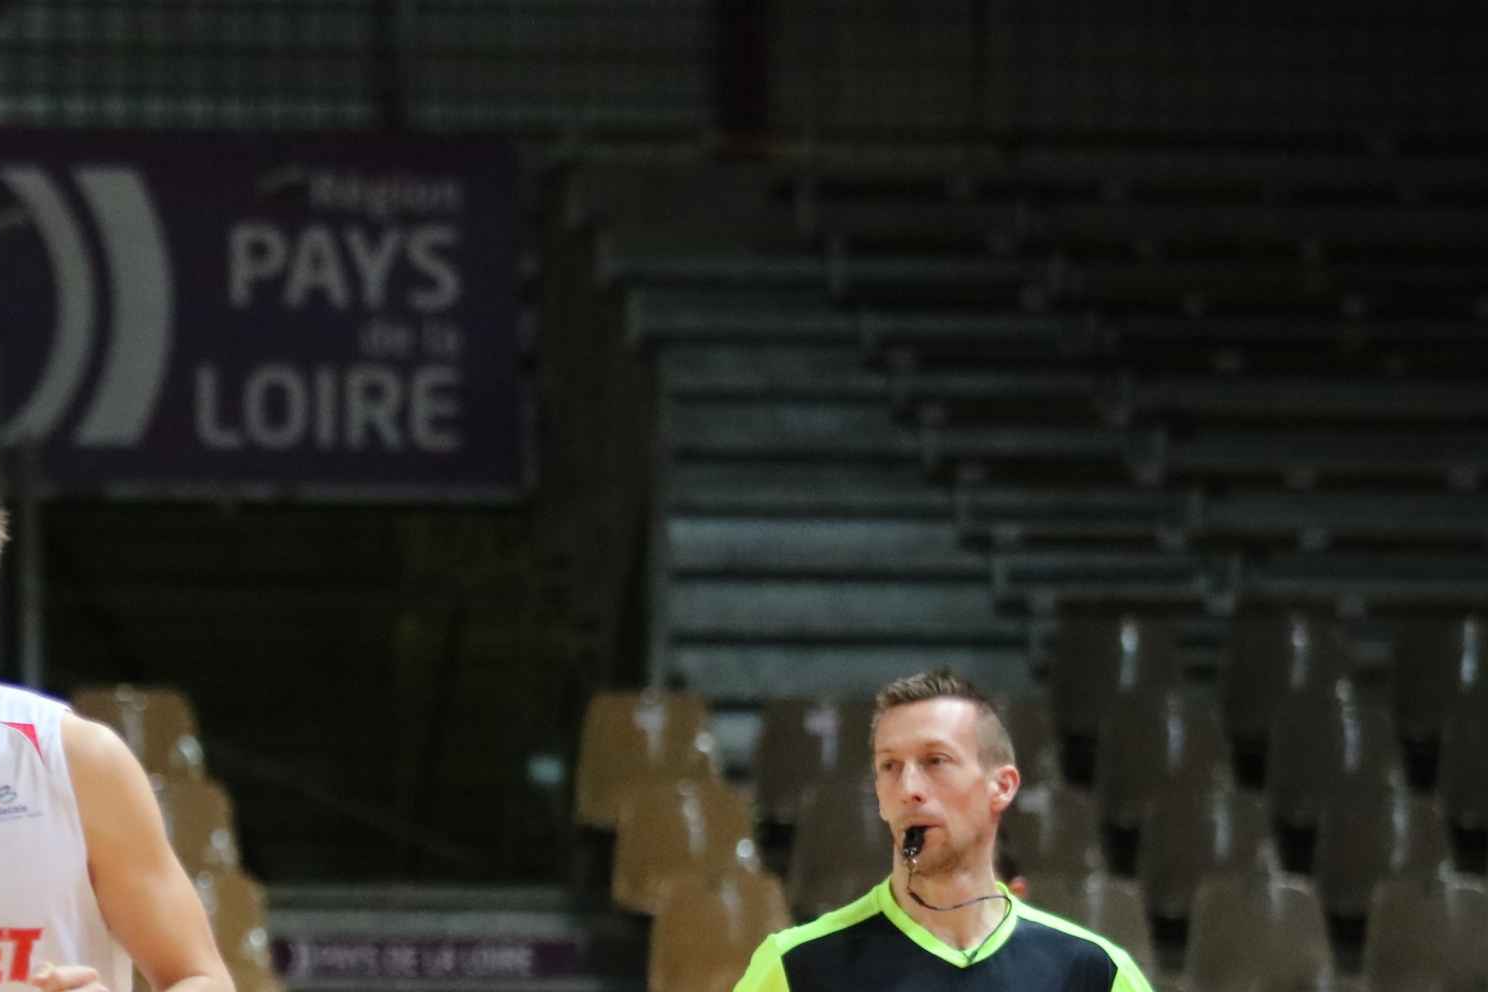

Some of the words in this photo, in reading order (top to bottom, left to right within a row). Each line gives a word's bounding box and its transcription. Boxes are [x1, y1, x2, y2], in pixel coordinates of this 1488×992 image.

[227, 220, 462, 311] PAYS
[193, 360, 463, 451] LOIRE
[313, 946, 377, 977] PAYS
[382, 946, 418, 977] DE
[422, 946, 455, 977] LA
[460, 946, 533, 977] LOIRE
